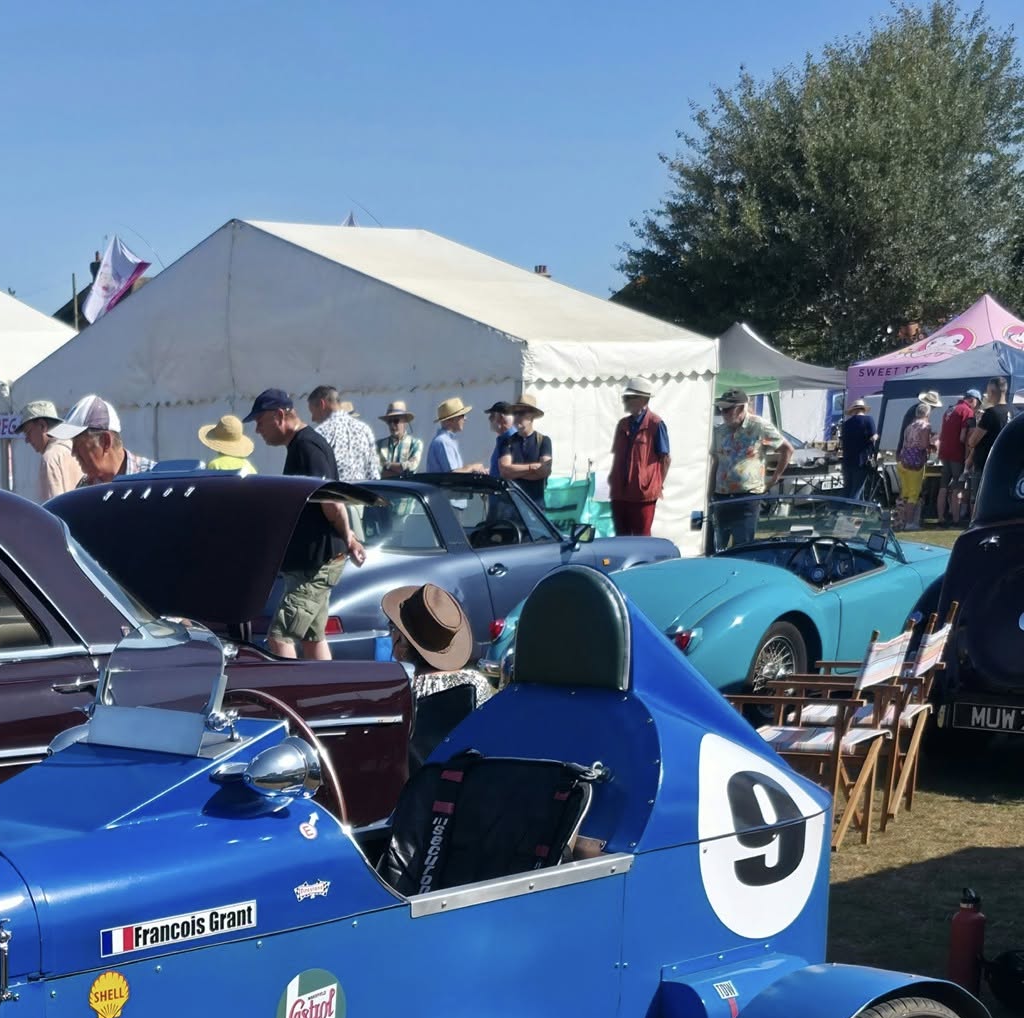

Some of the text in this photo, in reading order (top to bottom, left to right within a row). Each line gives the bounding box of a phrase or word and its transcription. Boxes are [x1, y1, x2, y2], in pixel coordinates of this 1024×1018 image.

[858, 367, 899, 377] SWEET
[971, 706, 1016, 730] MUW
[727, 770, 806, 887] 9
[134, 905, 253, 948] Francois Grant
[93, 987, 125, 1003] SHELL
